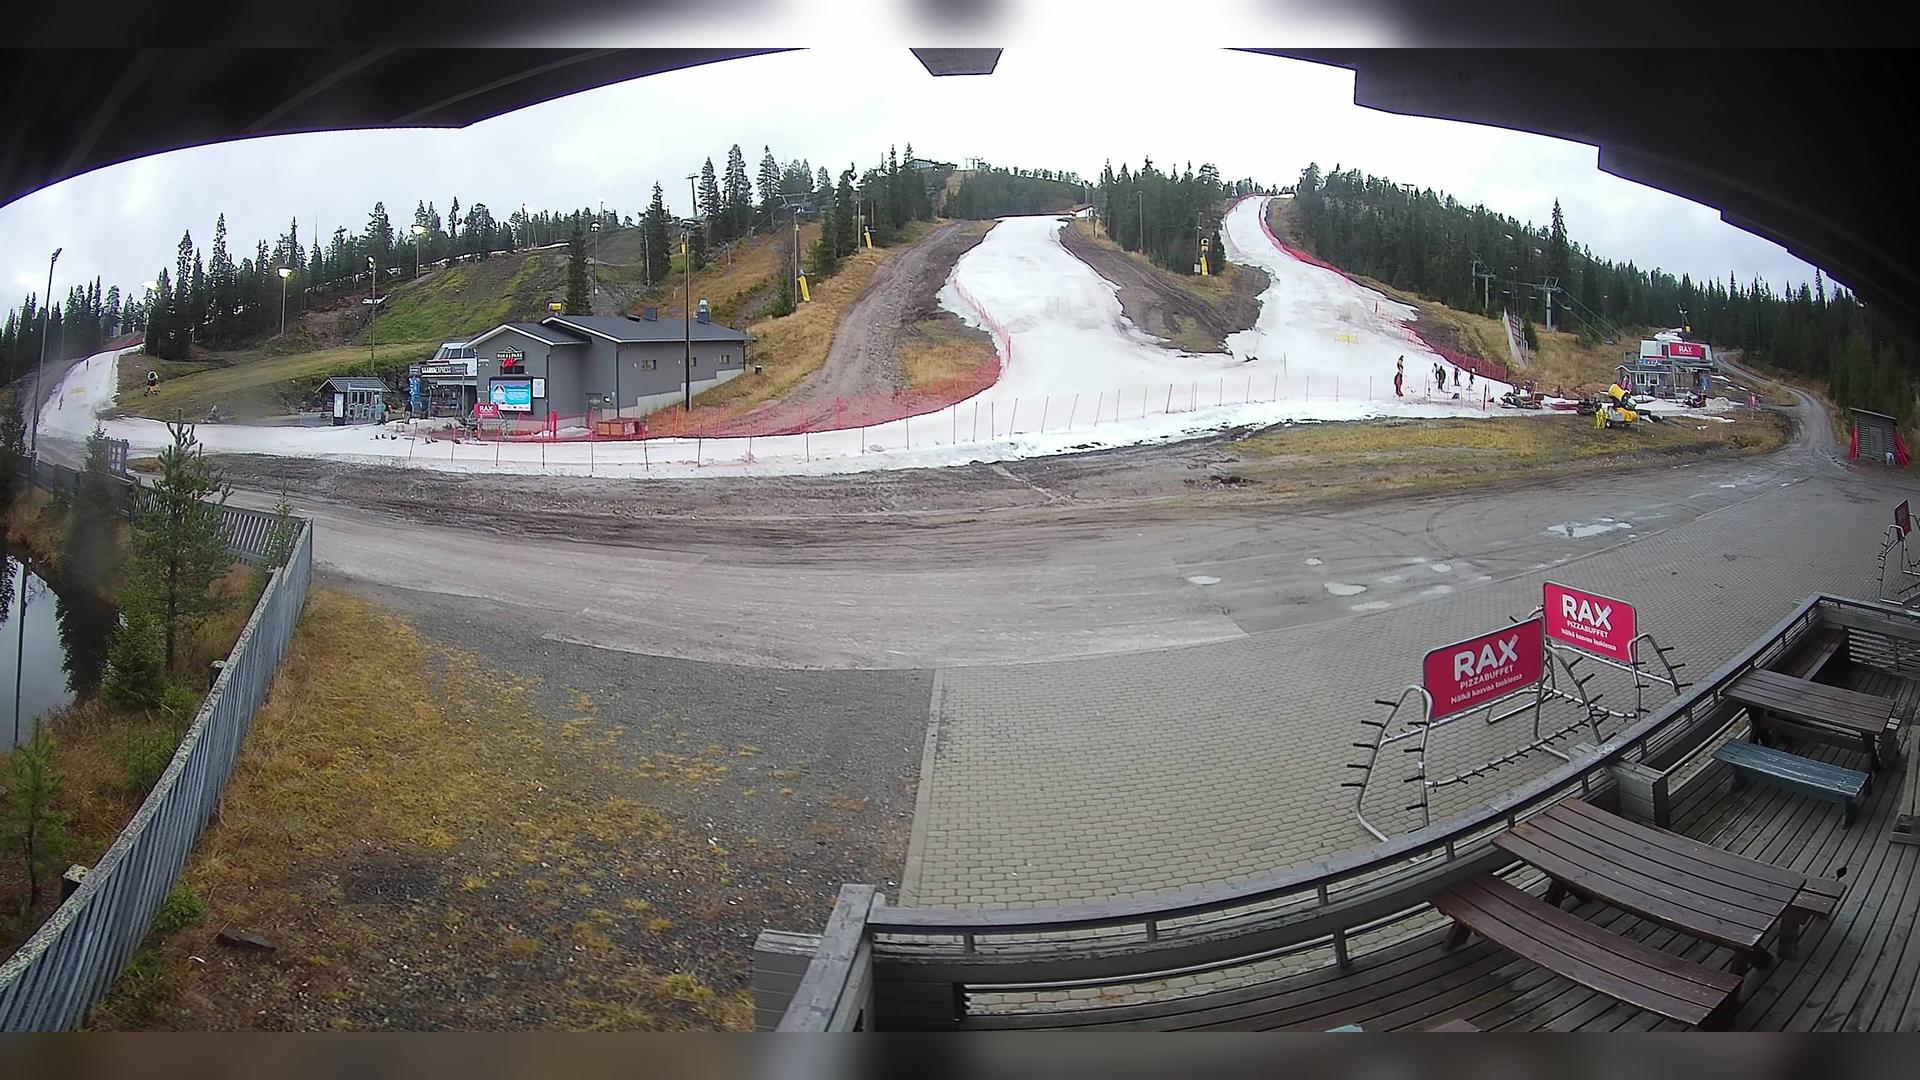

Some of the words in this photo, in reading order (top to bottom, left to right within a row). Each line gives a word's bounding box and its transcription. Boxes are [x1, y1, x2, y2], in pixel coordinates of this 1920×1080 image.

[479, 405, 494, 413] RAX
[1562, 593, 1612, 631] RAX
[1566, 620, 1608, 638] PIZZABUFFET
[1454, 634, 1519, 681] RAX
[1460, 664, 1514, 689] PIZZABUFFET
